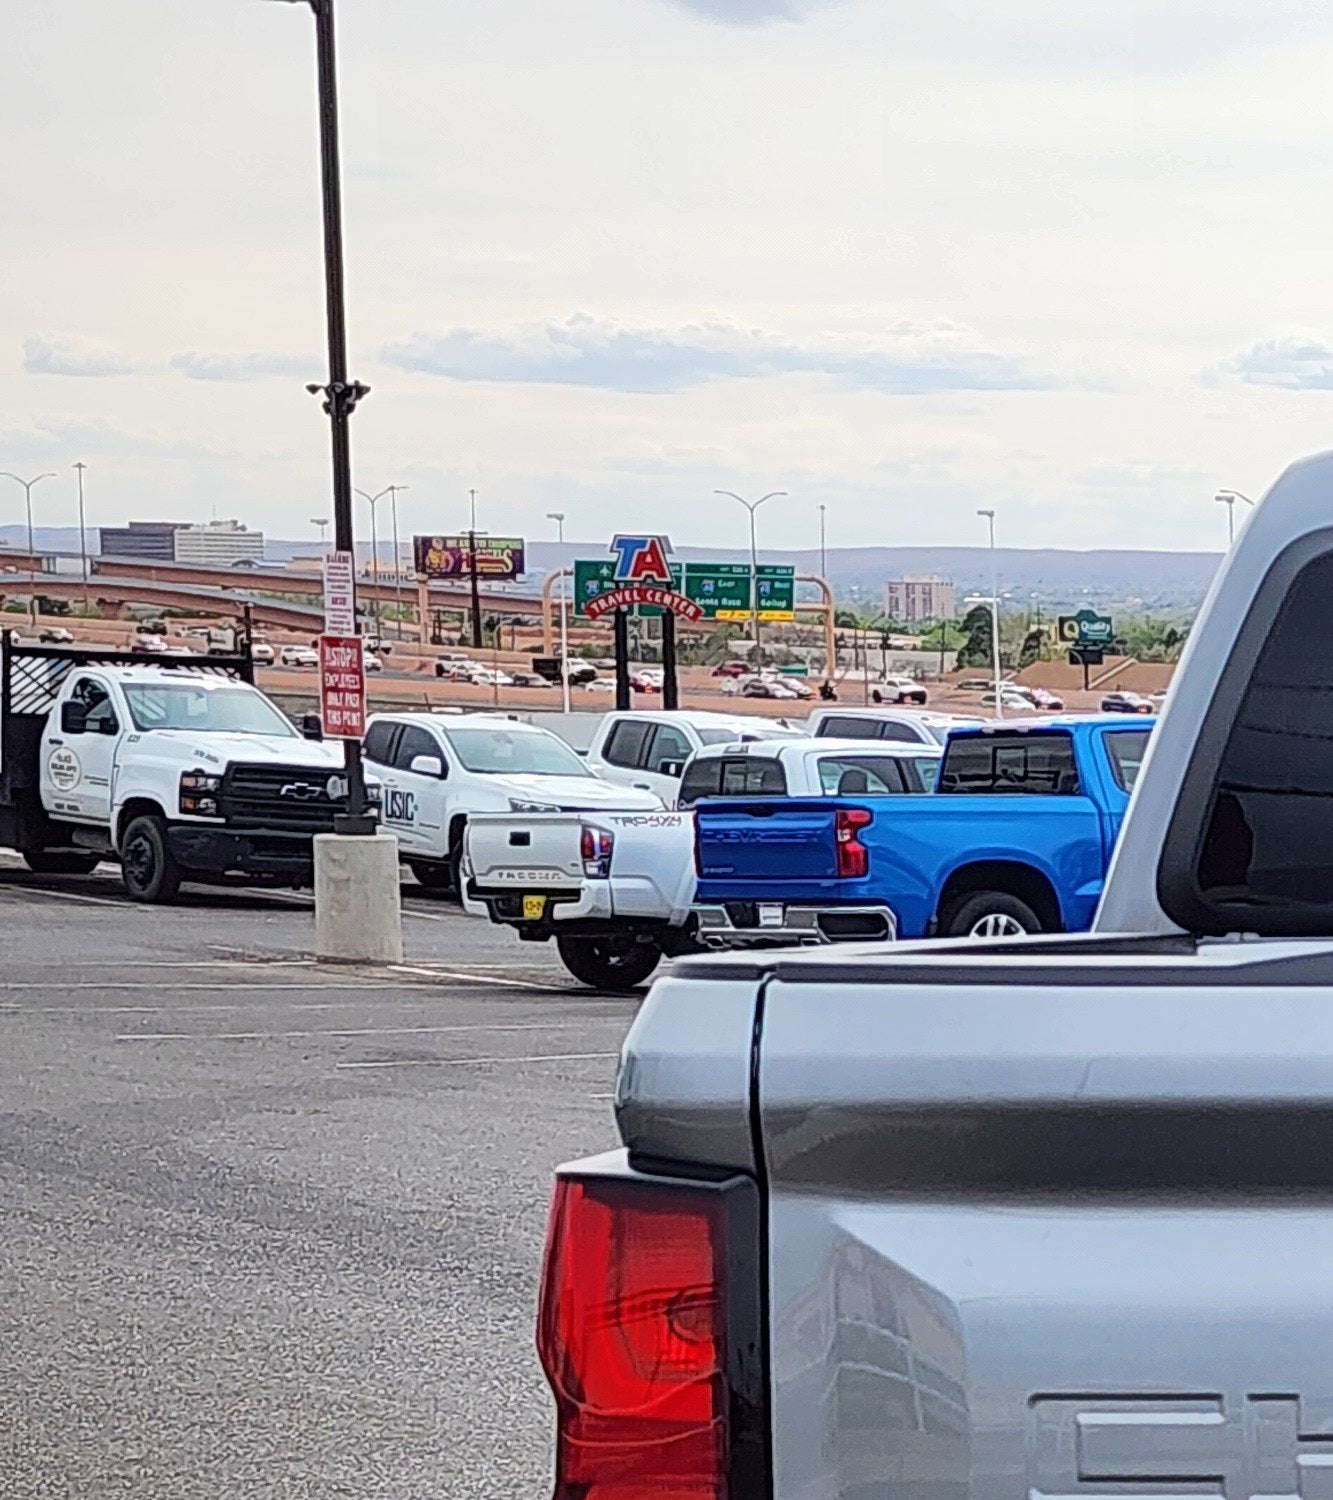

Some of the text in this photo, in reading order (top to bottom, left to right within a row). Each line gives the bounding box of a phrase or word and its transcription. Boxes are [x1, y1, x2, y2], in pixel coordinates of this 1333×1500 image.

[611, 535, 672, 582] TA
[590, 589, 697, 617] TRAVEL CENTER
[385, 789, 414, 821] USIC
